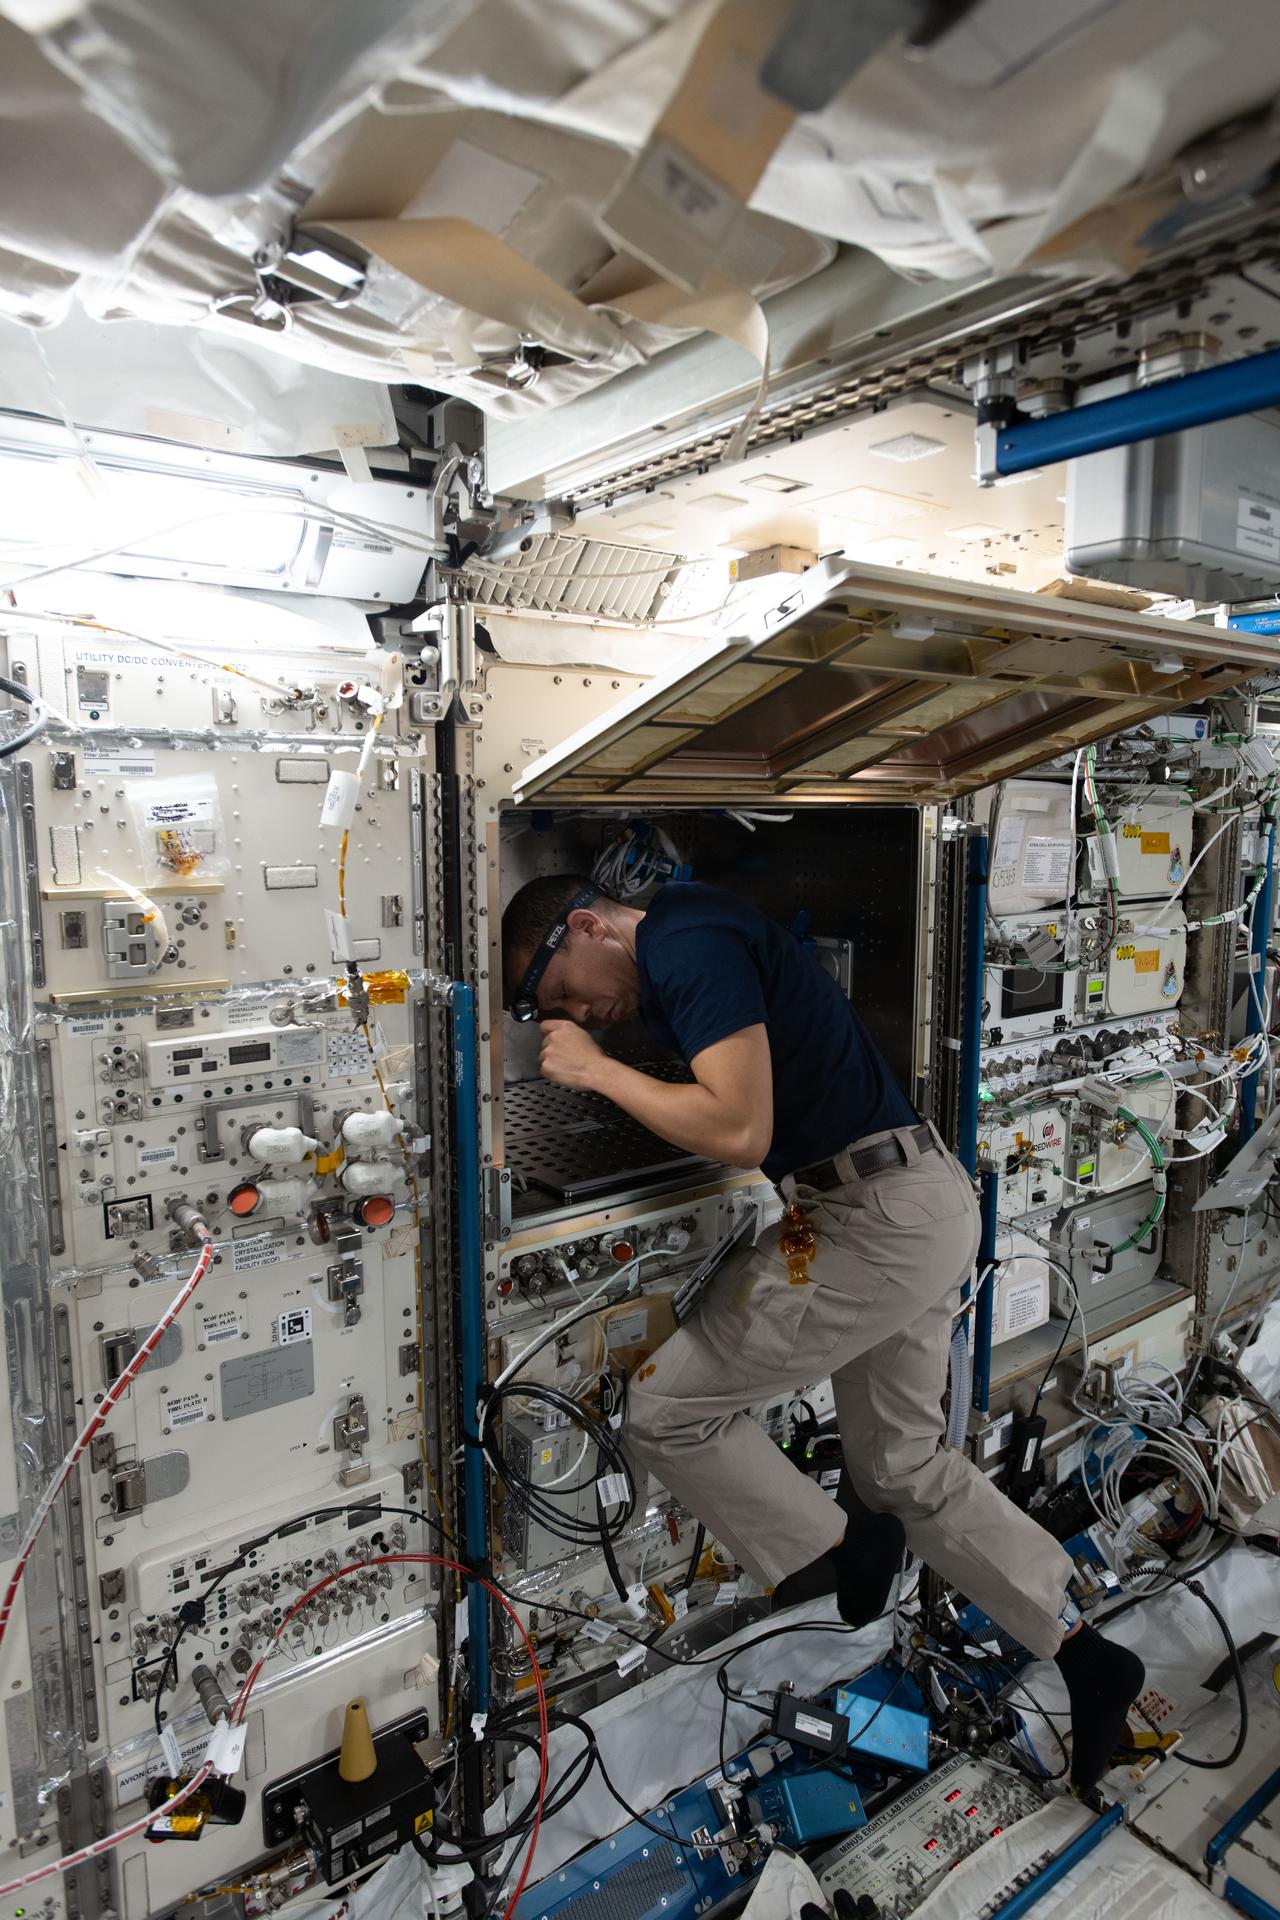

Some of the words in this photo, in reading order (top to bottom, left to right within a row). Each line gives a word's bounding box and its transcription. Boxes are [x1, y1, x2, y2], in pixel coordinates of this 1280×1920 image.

[76, 652, 114, 663] UTILITY
[117, 655, 148, 665] DC/DC
[546, 924, 566, 949] PETZL
[1034, 1137, 1062, 1152] REDWIRE
[234, 1238, 263, 1250] SOLUTION
[234, 1240, 285, 1257] CRYSTALLIZATION
[234, 1251, 275, 1264] OBSERVATION
[235, 1261, 260, 1271] FACILITY
[261, 1256, 281, 1265] (SCOF)
[218, 1310, 235, 1321] PASS
[203, 1322, 218, 1330] THRU
[219, 1317, 237, 1326] PLATE
[182, 1393, 199, 1402] PASS
[167, 1405, 183, 1414] THRU
[183, 1399, 202, 1410] PLATE
[120, 1763, 159, 1788] AVIONICS
[839, 1833, 864, 1855] MINUS
[862, 1815, 887, 1836] EIGHTY
[887, 1805, 902, 1818] LAB
[900, 1783, 931, 1807] FREEZER
[930, 1774, 941, 1786] ISS
